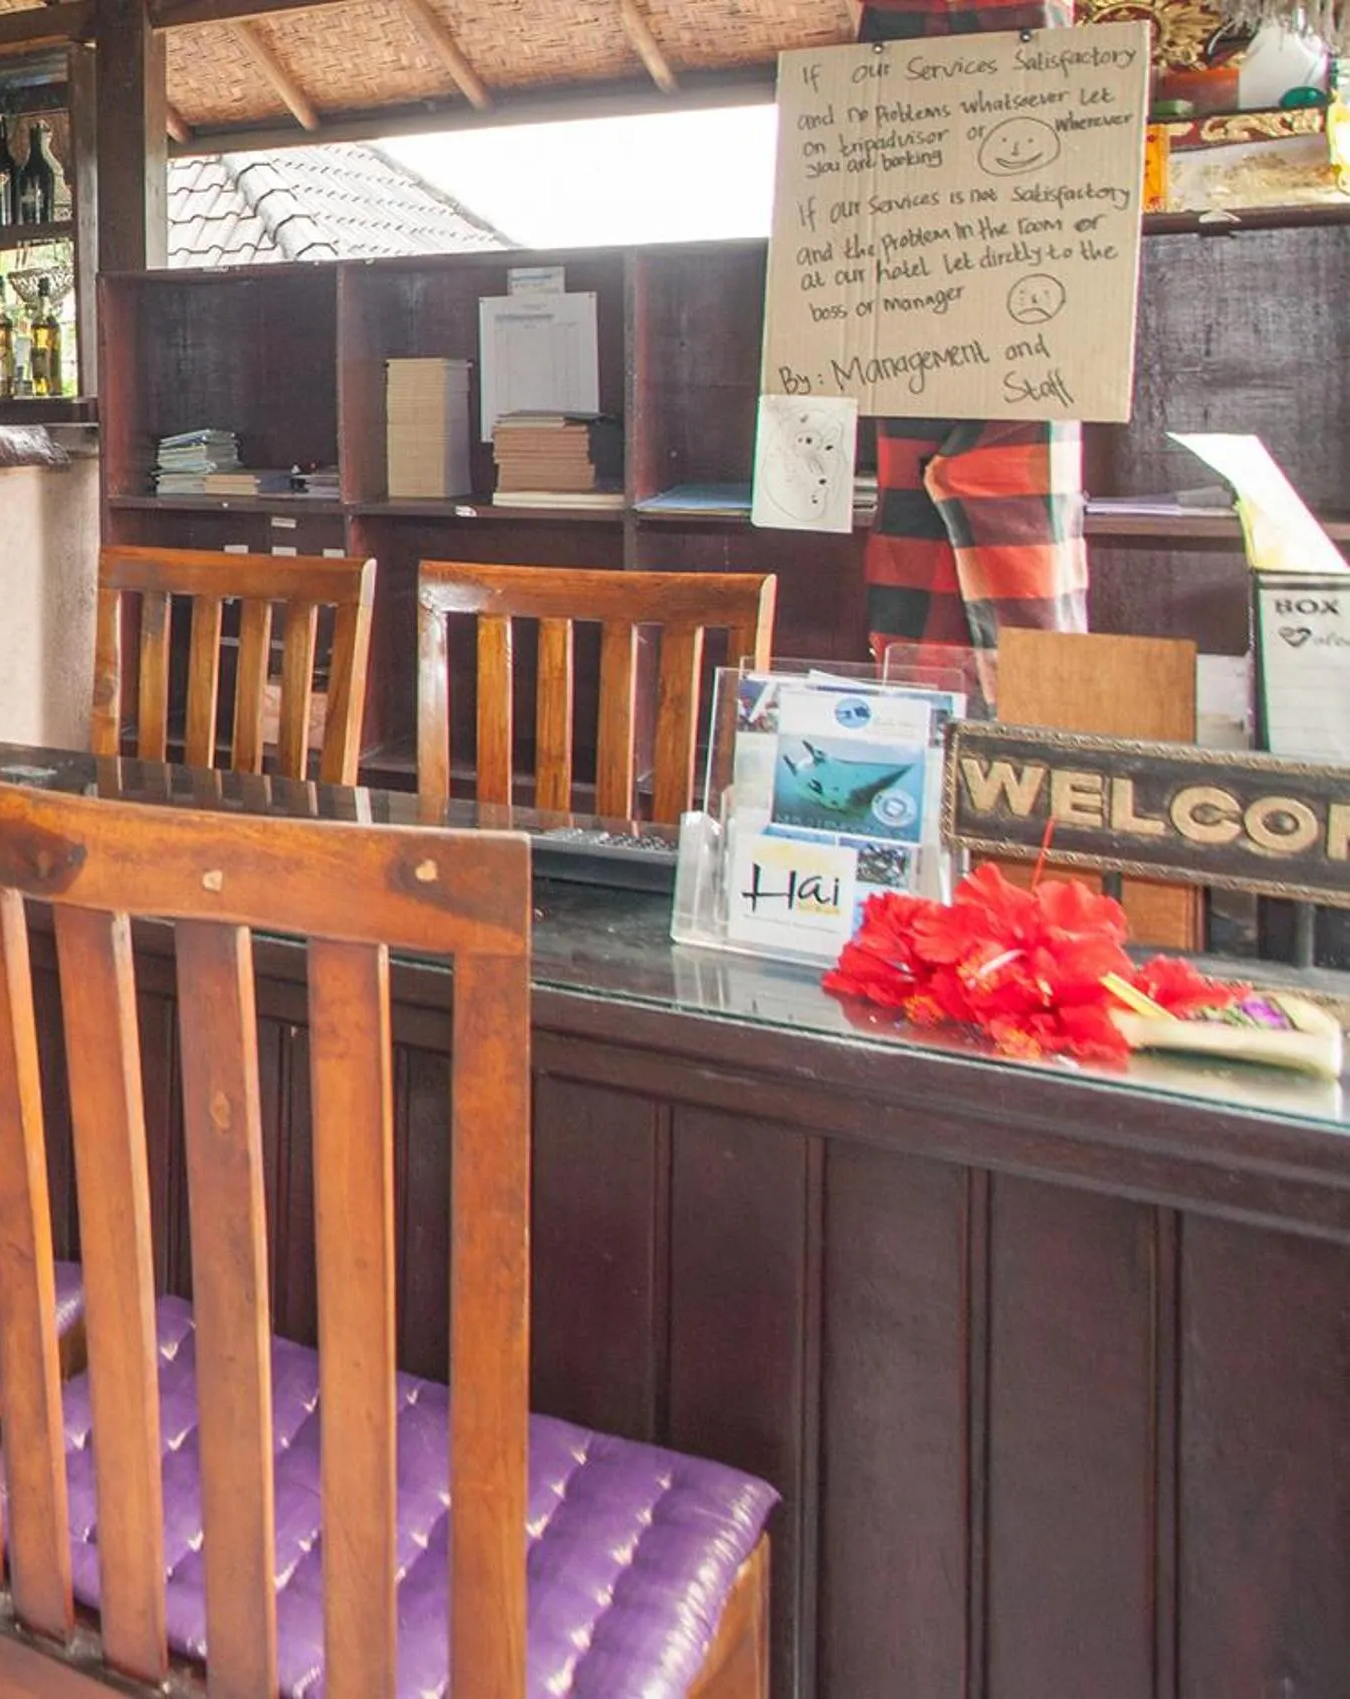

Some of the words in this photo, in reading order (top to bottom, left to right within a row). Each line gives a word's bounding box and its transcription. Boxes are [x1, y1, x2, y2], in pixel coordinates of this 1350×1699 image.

[852, 63, 891, 84] our
[906, 56, 999, 82] Services
[1012, 46, 1138, 79] Satisfactory
[798, 104, 834, 131] and
[848, 105, 870, 123] no
[803, 140, 827, 157] on
[839, 129, 950, 157] tripadvisor
[966, 125, 987, 142] or
[805, 161, 841, 179] you
[847, 157, 877, 174] are
[881, 149, 943, 173] booking
[829, 198, 862, 224] our
[970, 187, 998, 203] not
[796, 241, 834, 266] and
[844, 233, 876, 259] the
[978, 214, 1009, 241] the
[1018, 216, 1062, 235] room
[1074, 213, 1107, 233] or
[800, 271, 825, 291] at
[835, 267, 866, 286] our
[875, 256, 931, 284] hotel
[1045, 243, 1073, 260] to
[1080, 238, 1118, 261] the
[808, 302, 849, 322] boss
[856, 301, 874, 318] or
[883, 285, 966, 314] manager
[831, 338, 991, 396] Management
[1004, 332, 1050, 360] and
[1002, 368, 1075, 408] Staff
[1274, 598, 1342, 616] BOX
[741, 862, 840, 913] Hai
